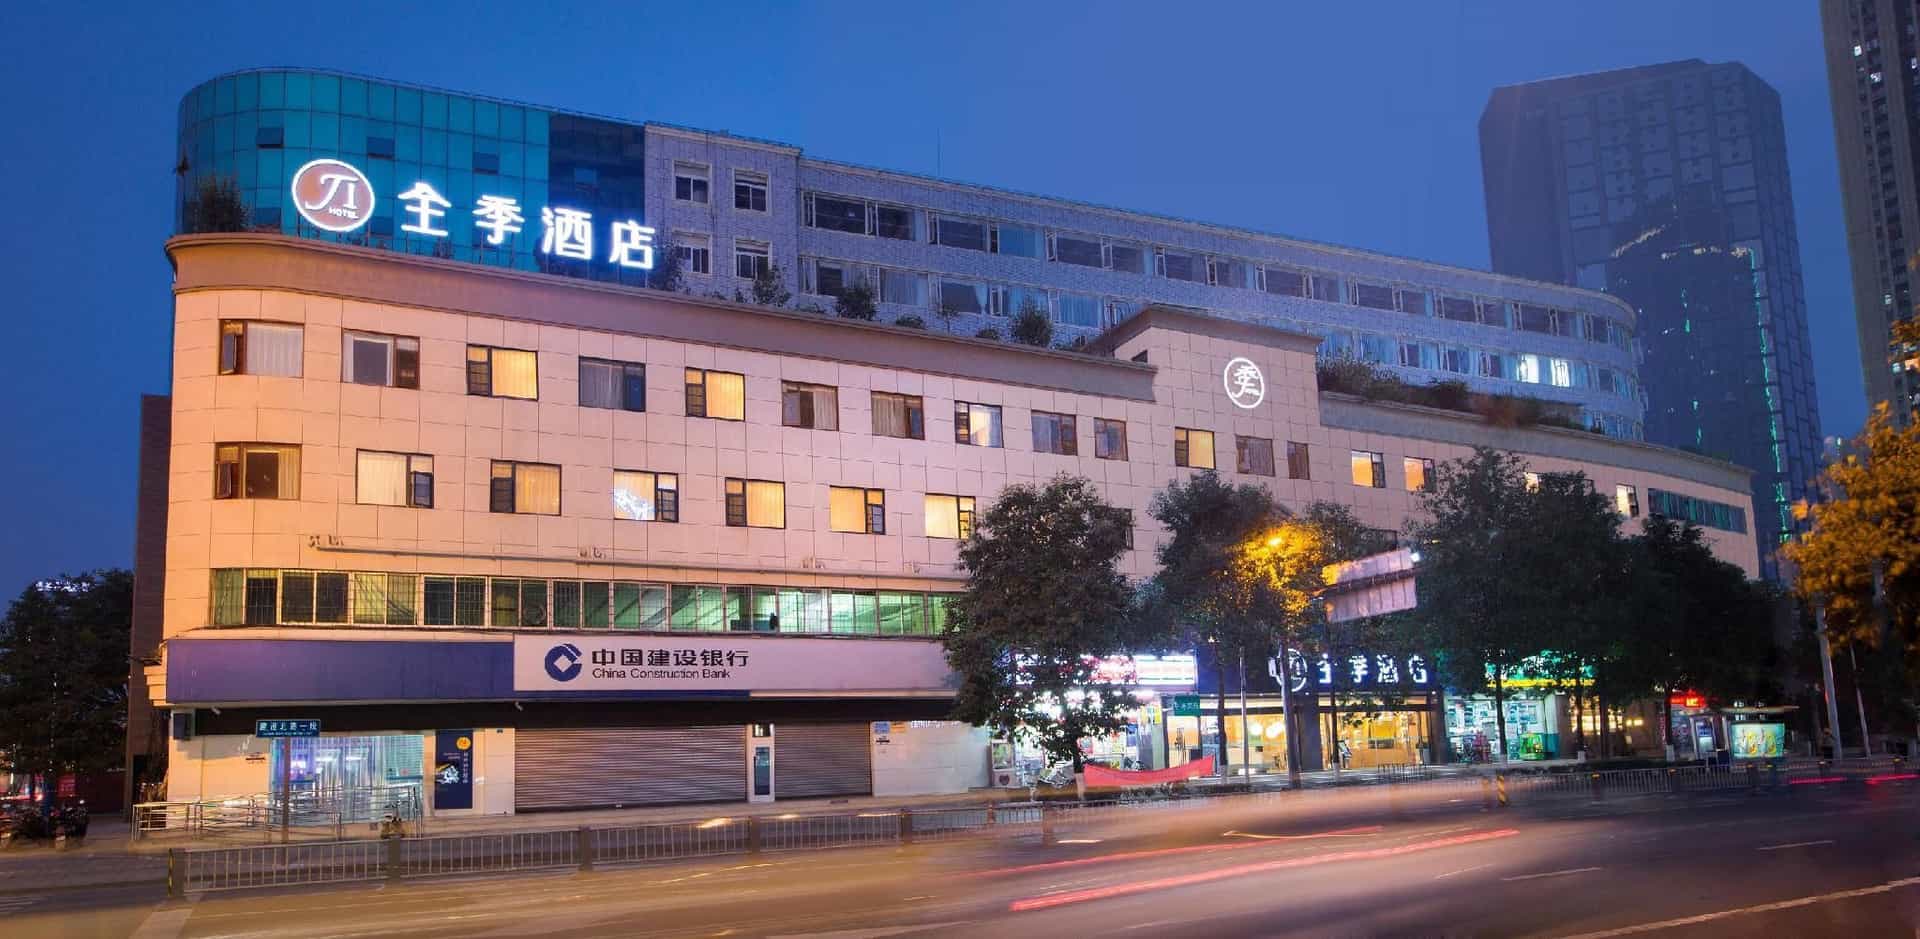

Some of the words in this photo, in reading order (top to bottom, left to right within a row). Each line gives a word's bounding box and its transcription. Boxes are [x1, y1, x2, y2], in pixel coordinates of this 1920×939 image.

[328, 206, 360, 219] HOTEL
[397, 182, 656, 270] 全季酒店
[591, 648, 749, 667] 中国建设银行
[592, 668, 626, 679] China
[630, 668, 699, 679] Construction
[702, 668, 731, 679] Bank
